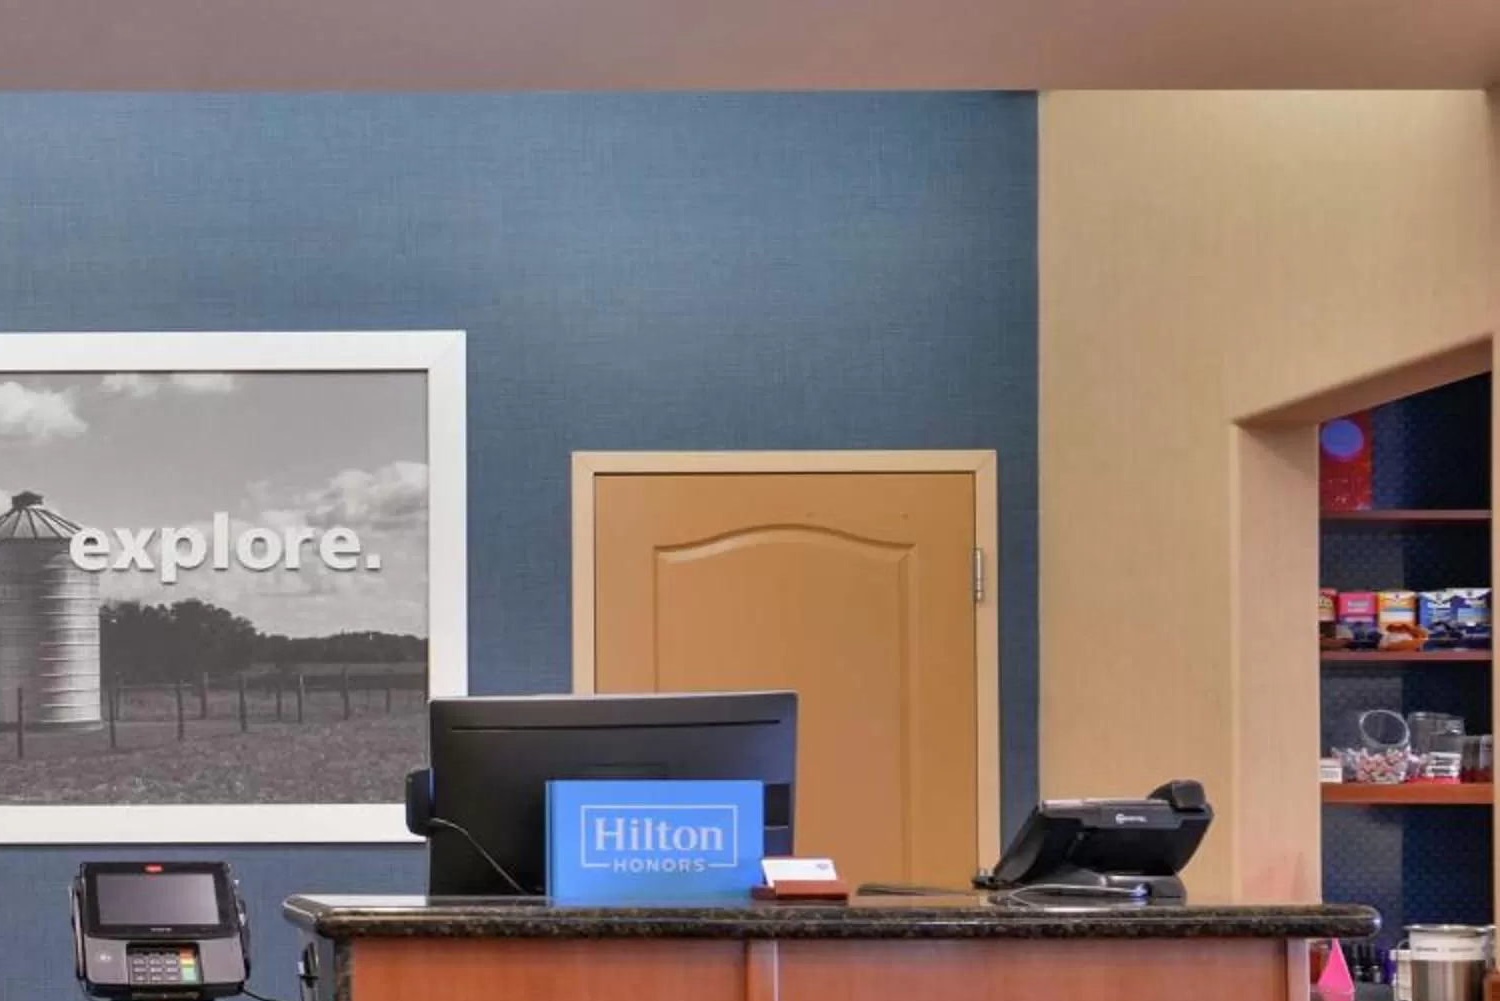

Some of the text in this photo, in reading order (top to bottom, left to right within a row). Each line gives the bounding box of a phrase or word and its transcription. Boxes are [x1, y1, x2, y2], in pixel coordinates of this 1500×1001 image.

[69, 511, 381, 584] explore.
[595, 816, 724, 851] Hilton
[613, 857, 706, 873] HONORS
